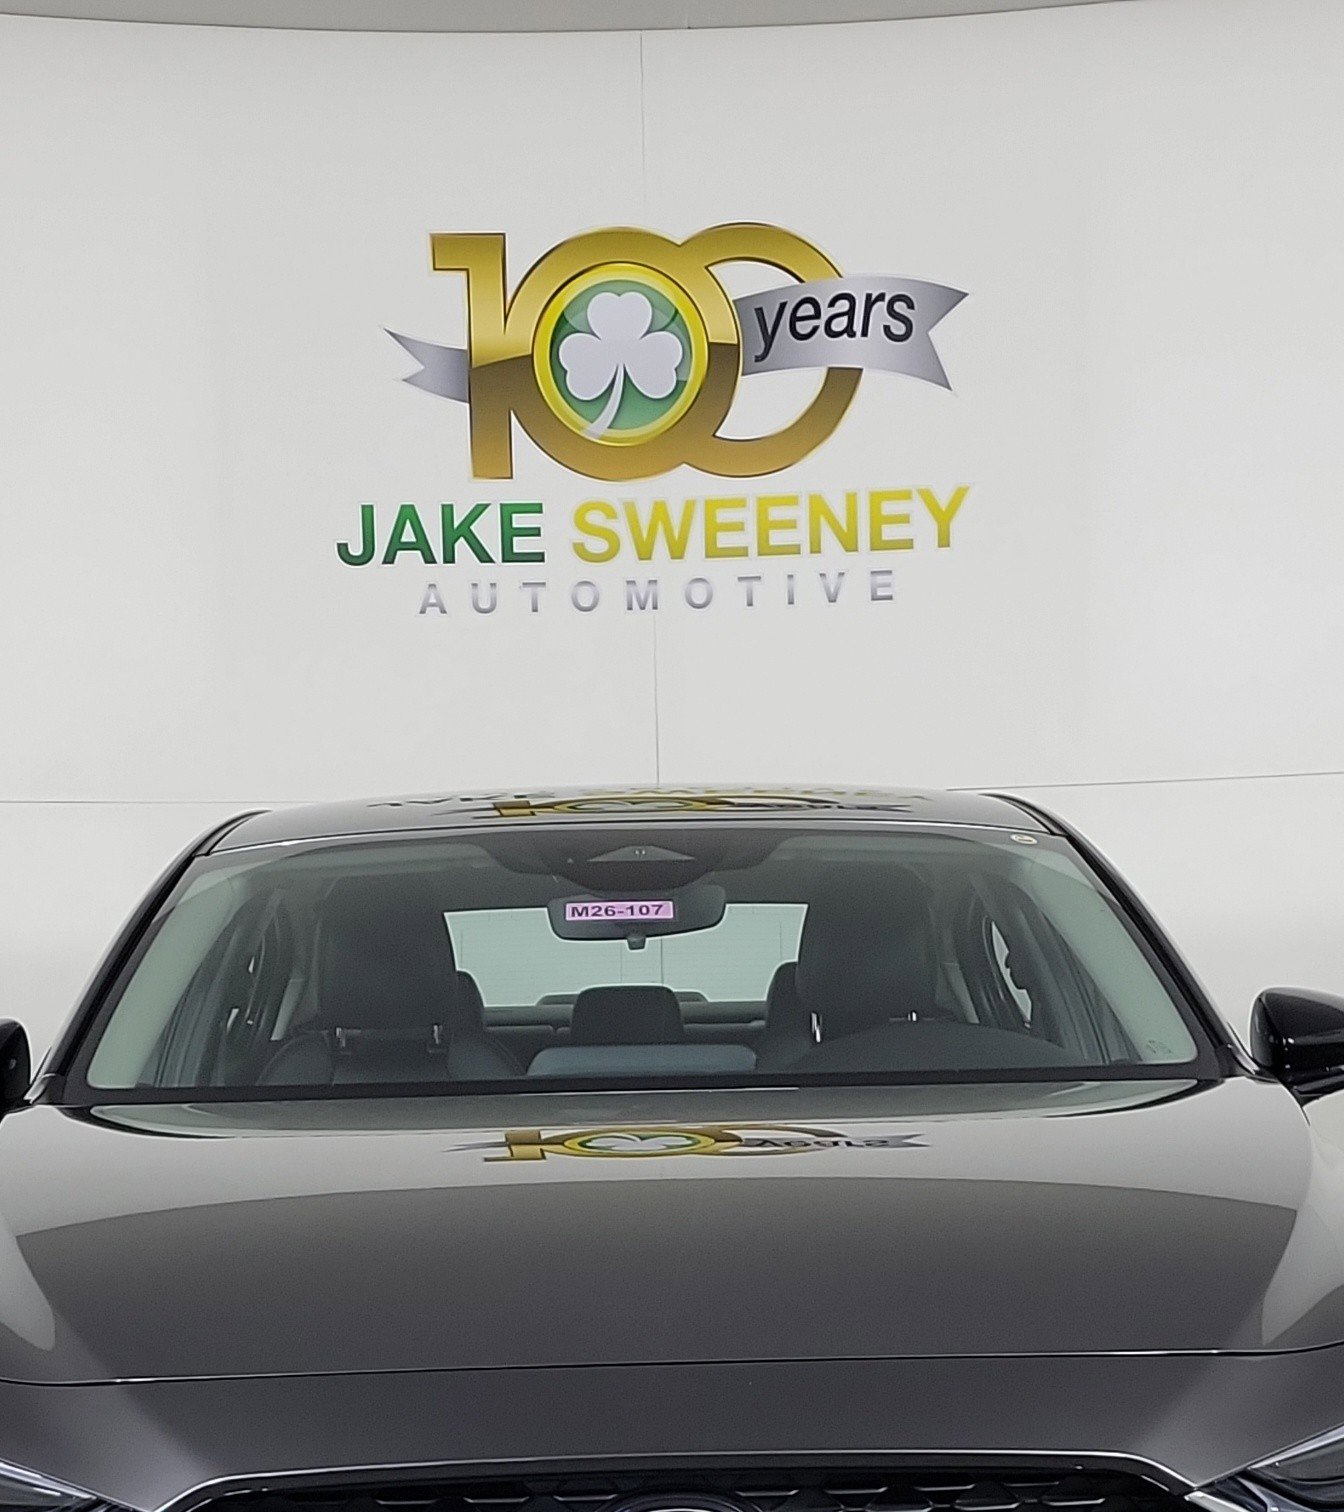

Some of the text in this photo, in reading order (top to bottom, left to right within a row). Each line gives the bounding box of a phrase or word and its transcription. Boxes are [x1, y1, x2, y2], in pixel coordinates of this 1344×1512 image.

[430, 221, 916, 482] 100 years
[337, 485, 970, 567] JAKE SWEENEY
[418, 569, 895, 616] AUTOMOTIVE
[571, 904, 664, 917] M26-107
